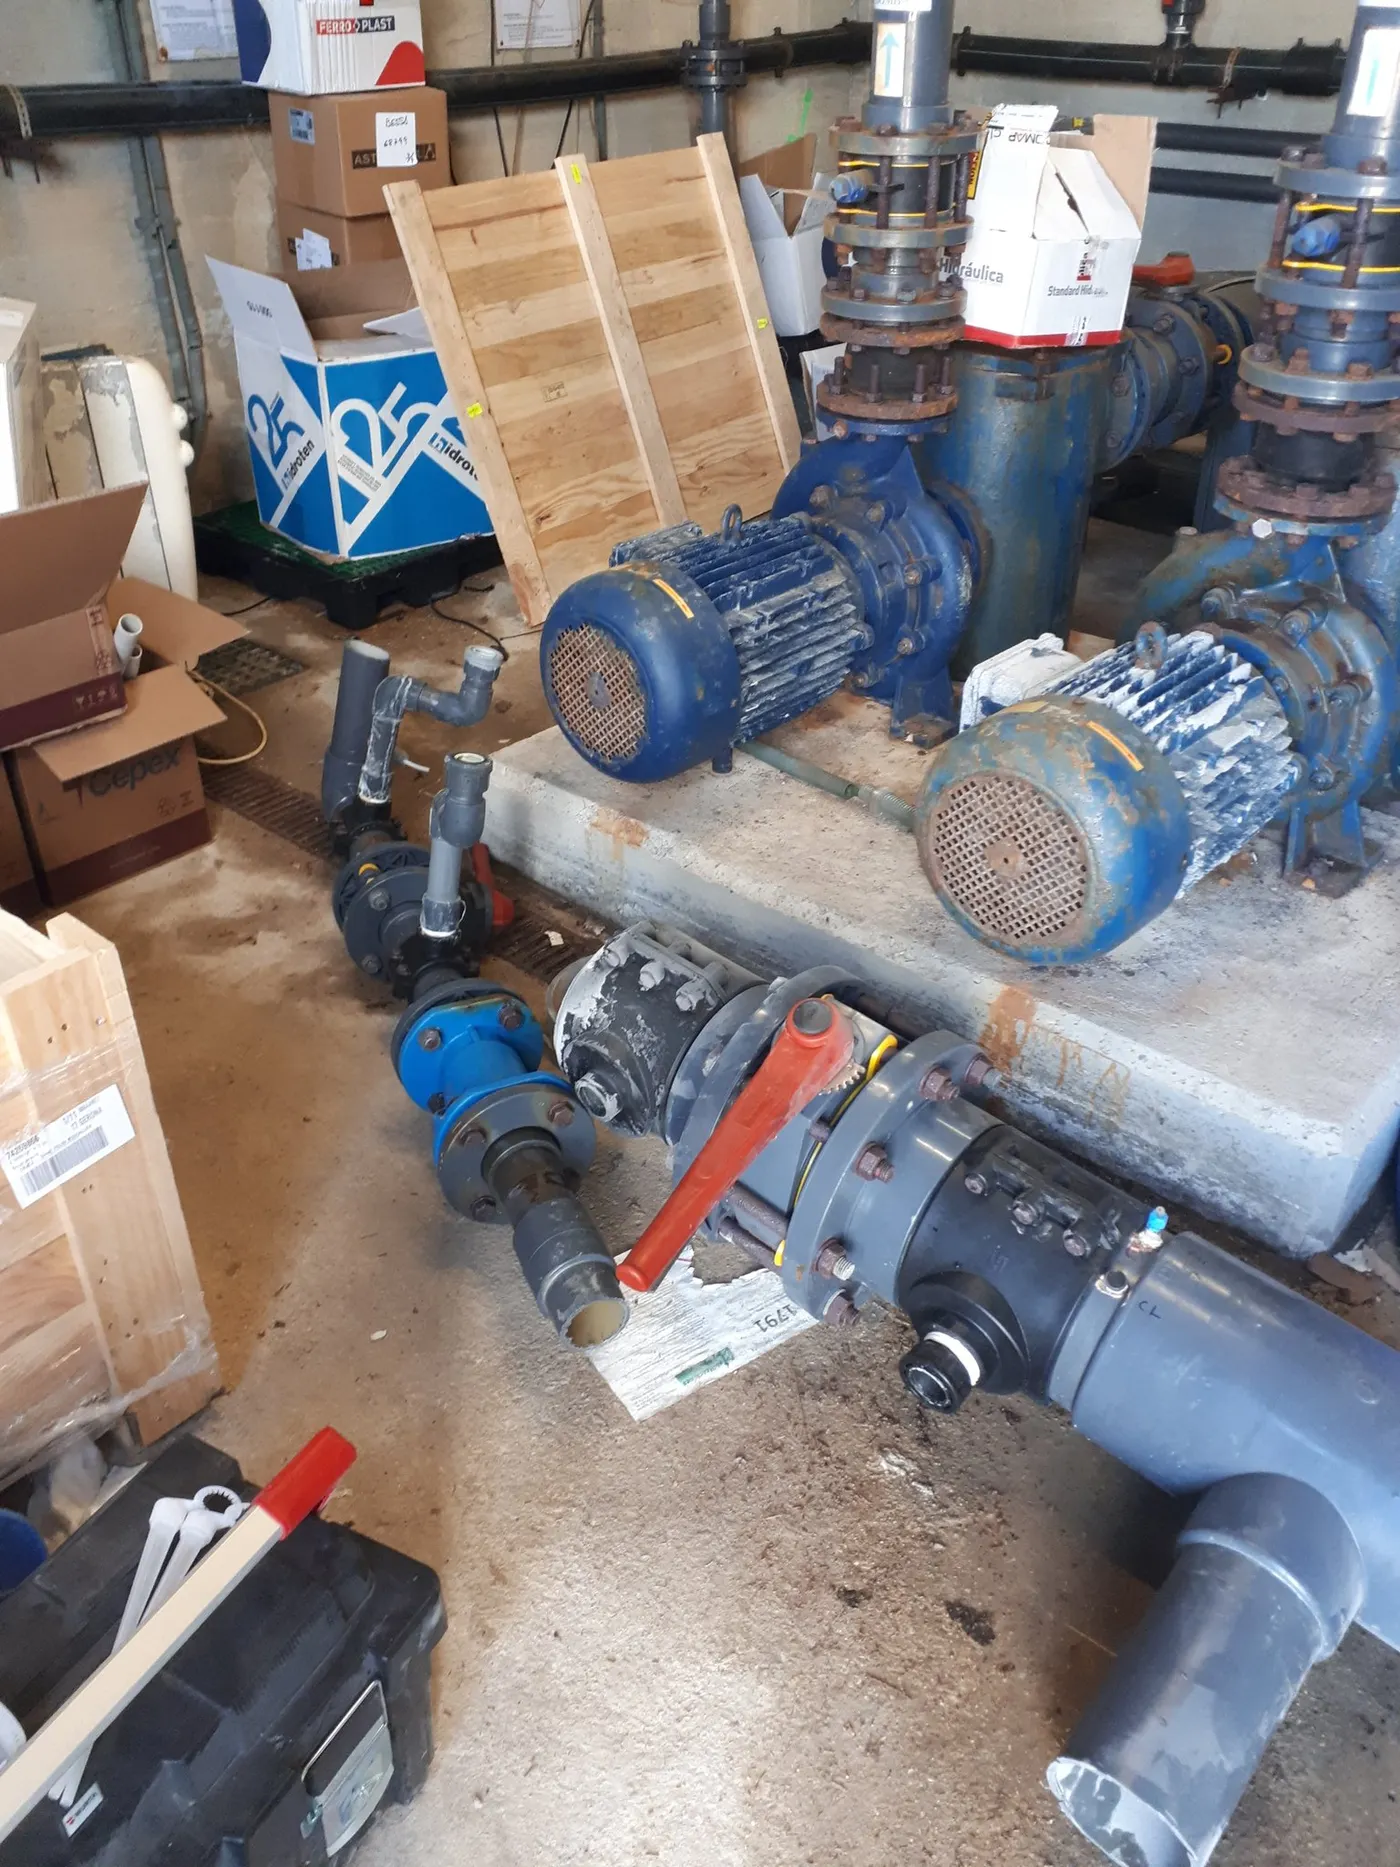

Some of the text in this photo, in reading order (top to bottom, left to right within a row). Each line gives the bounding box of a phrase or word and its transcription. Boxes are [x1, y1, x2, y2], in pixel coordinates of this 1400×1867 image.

[319, 17, 393, 34] FERRO PLAST
[1046, 285, 1080, 297] Standard
[89, 740, 181, 797] Cepex
[753, 1303, 798, 1333] 1791
